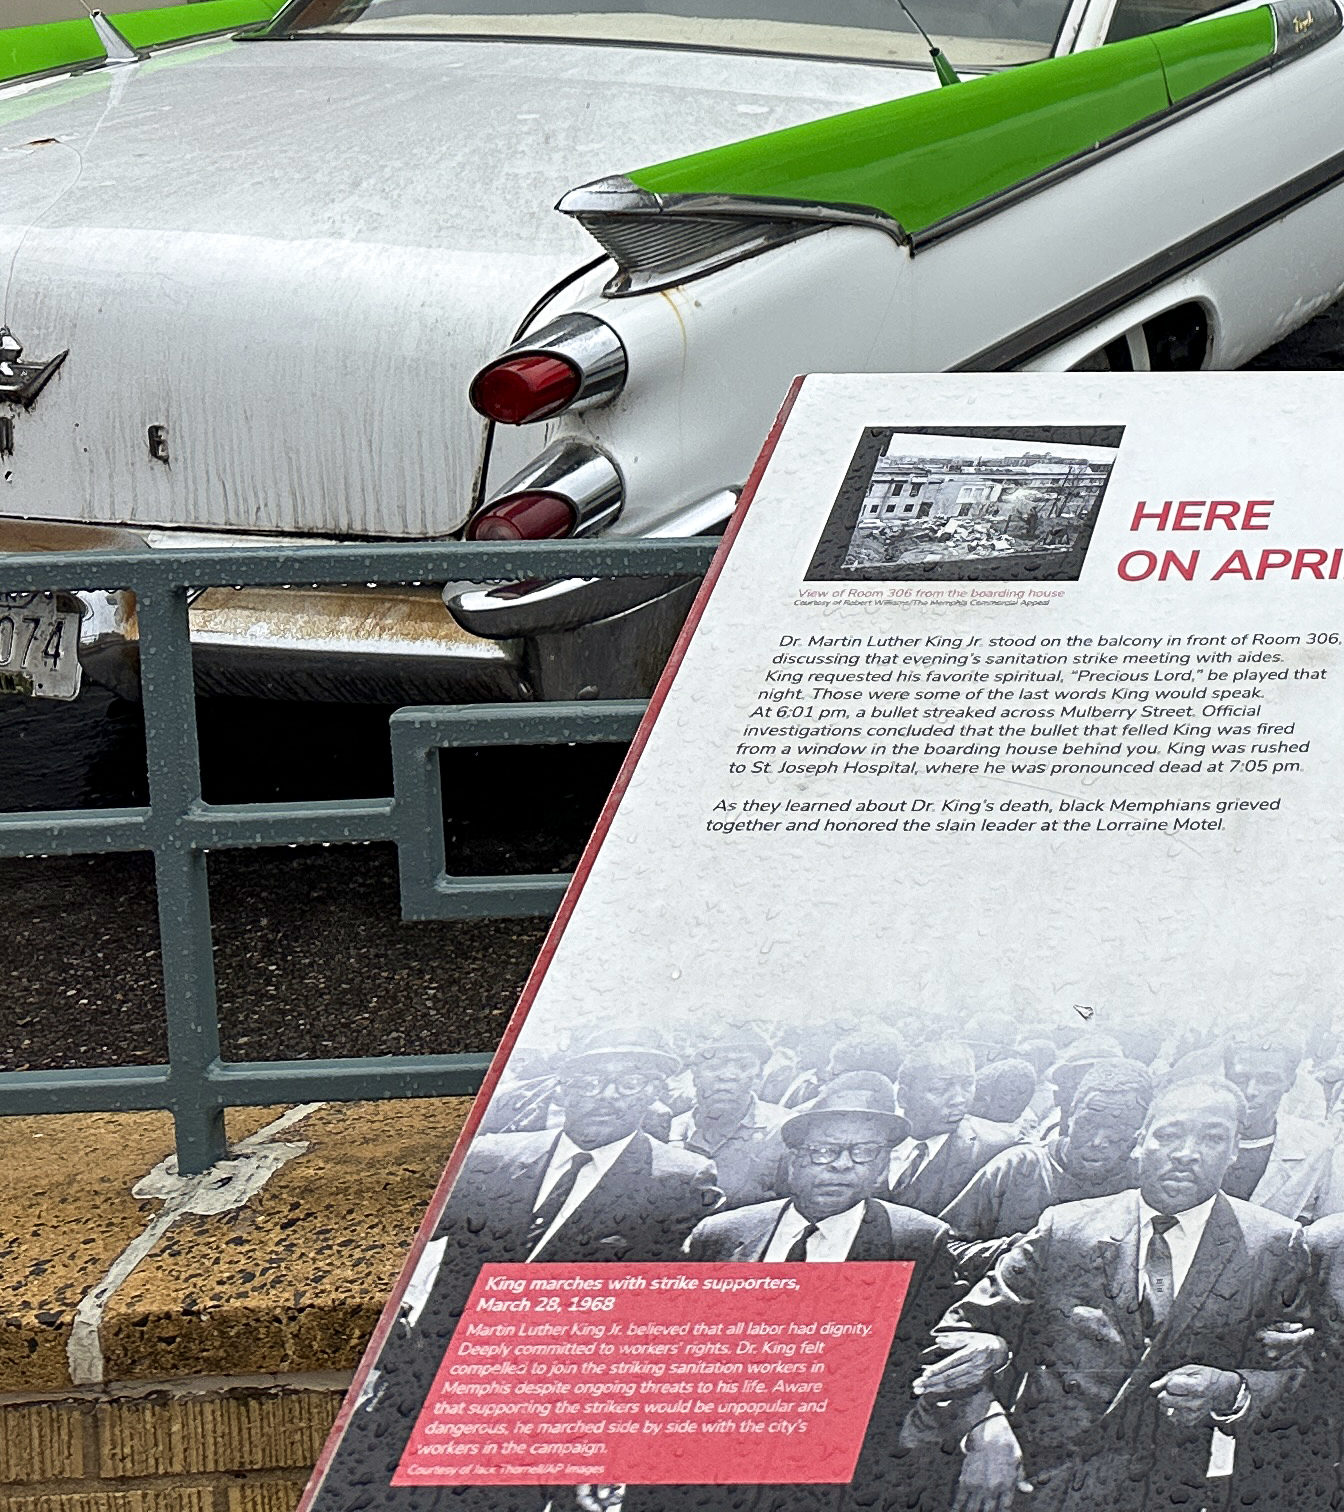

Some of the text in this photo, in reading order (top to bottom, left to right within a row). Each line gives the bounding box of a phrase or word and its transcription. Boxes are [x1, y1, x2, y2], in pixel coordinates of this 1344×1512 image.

[1129, 499, 1274, 531] HERE
[1117, 549, 1200, 581] ON
[798, 588, 1065, 600] View of Room 306 from the boarding house
[778, 632, 1341, 649] Dr. Martin Luther King Jr. stood on the balcony in front of Room 306,
[772, 650, 1283, 666] discussing that evening's sanitation strike meeting with aides.
[764, 669, 803, 684] King
[807, 670, 893, 684] requested
[896, 669, 921, 682] his
[925, 670, 989, 682] favorite
[993, 669, 1063, 684] spiritual,
[1207, 669, 1228, 680] be
[1232, 667, 1289, 683] played
[1294, 667, 1327, 679] that
[484, 1275, 800, 1293] King marches with strike supporters,
[476, 1296, 615, 1312] March 28, 1968
[465, 1321, 872, 1338] Martin Luther King Jr. believed that all labor had dignity.
